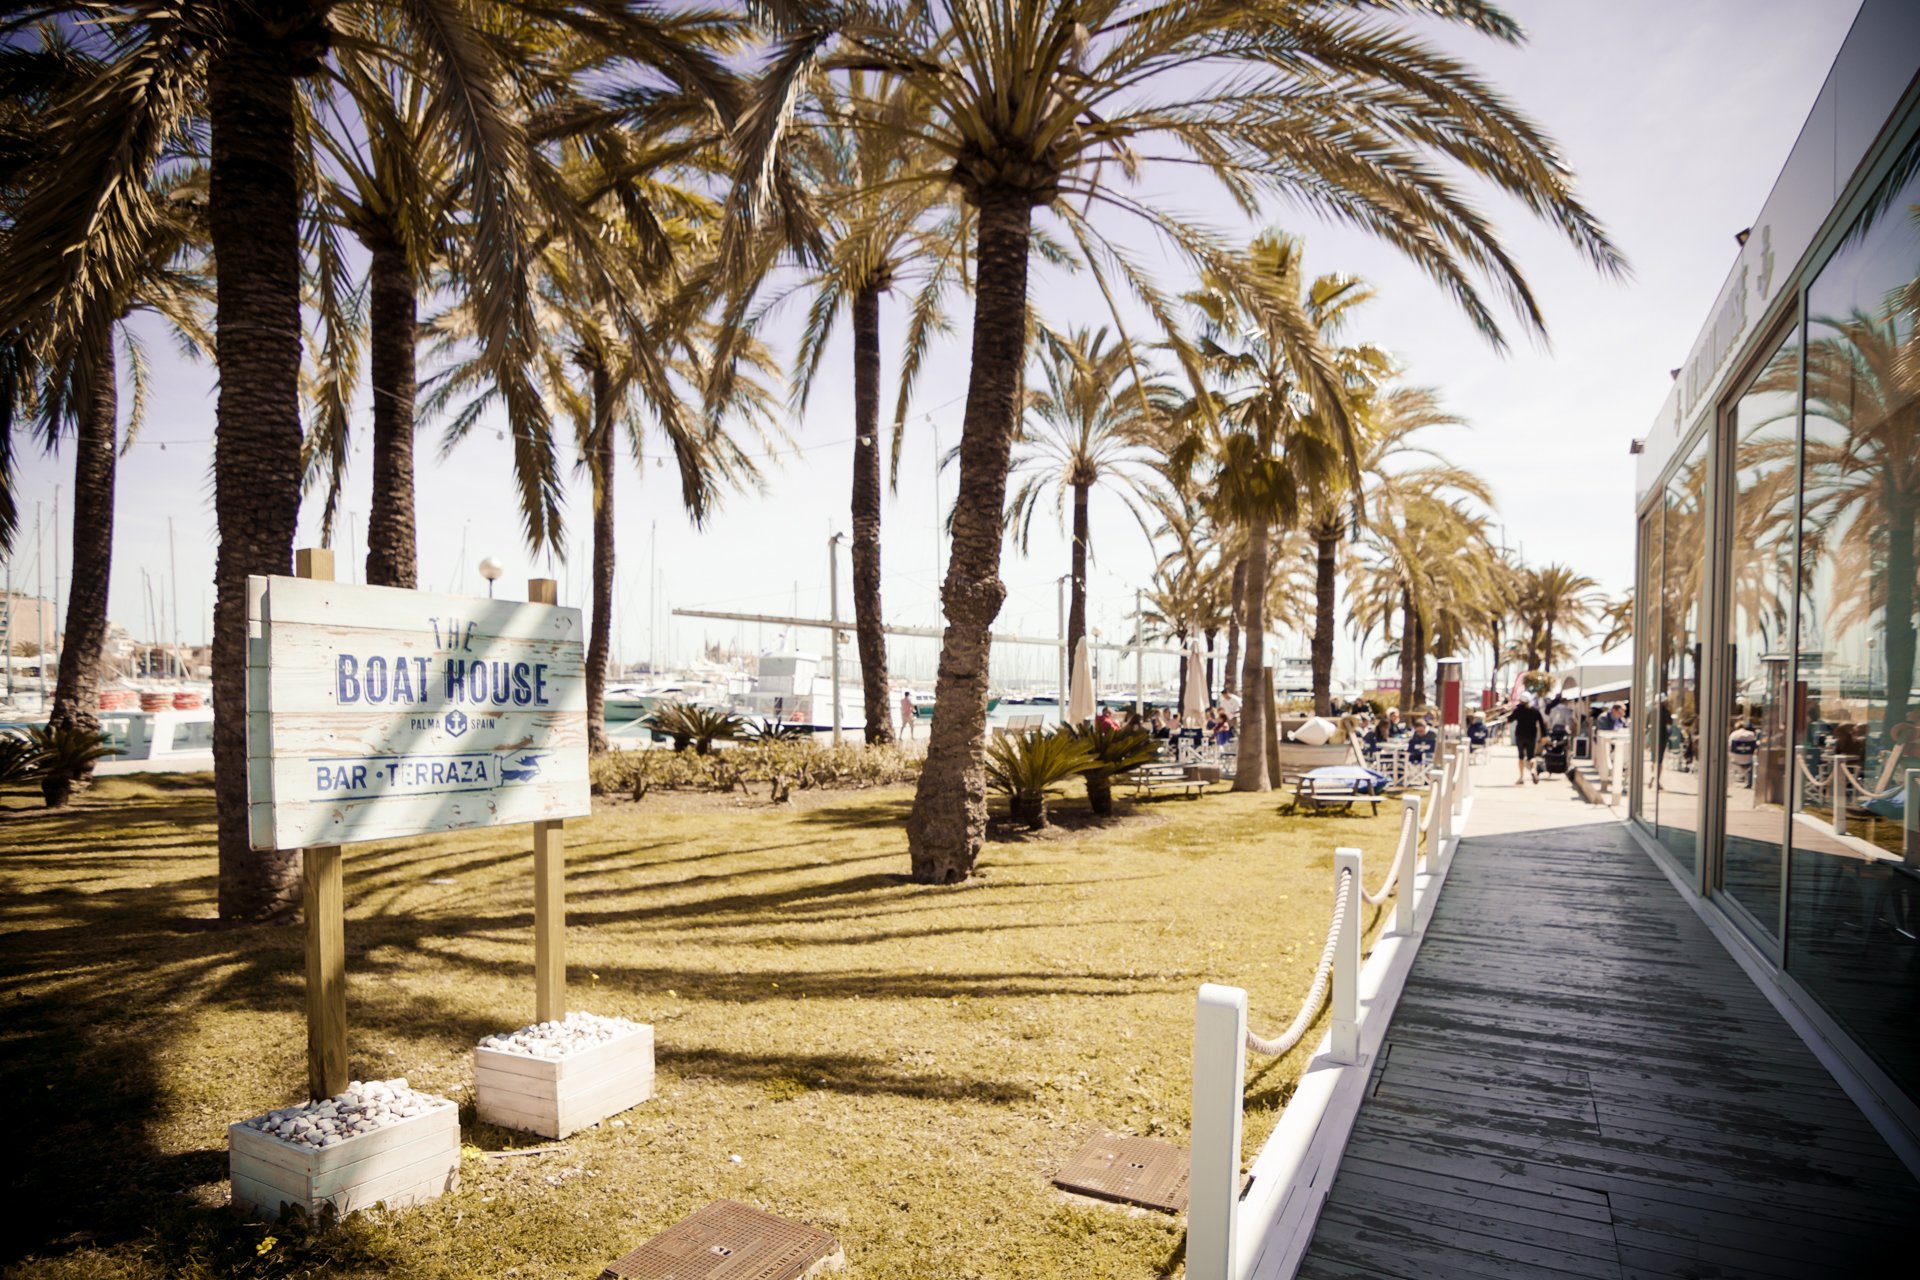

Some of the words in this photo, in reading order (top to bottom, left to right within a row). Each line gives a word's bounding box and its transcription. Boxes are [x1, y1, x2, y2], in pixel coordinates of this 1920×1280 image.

[428, 616, 478, 653] THE
[336, 654, 433, 704] BOAT
[446, 658, 549, 705] HOUSE
[411, 718, 441, 730] PALMA
[470, 718, 495, 730] SPAIN
[316, 764, 368, 791] BAR
[385, 760, 489, 787] TERRAZA
